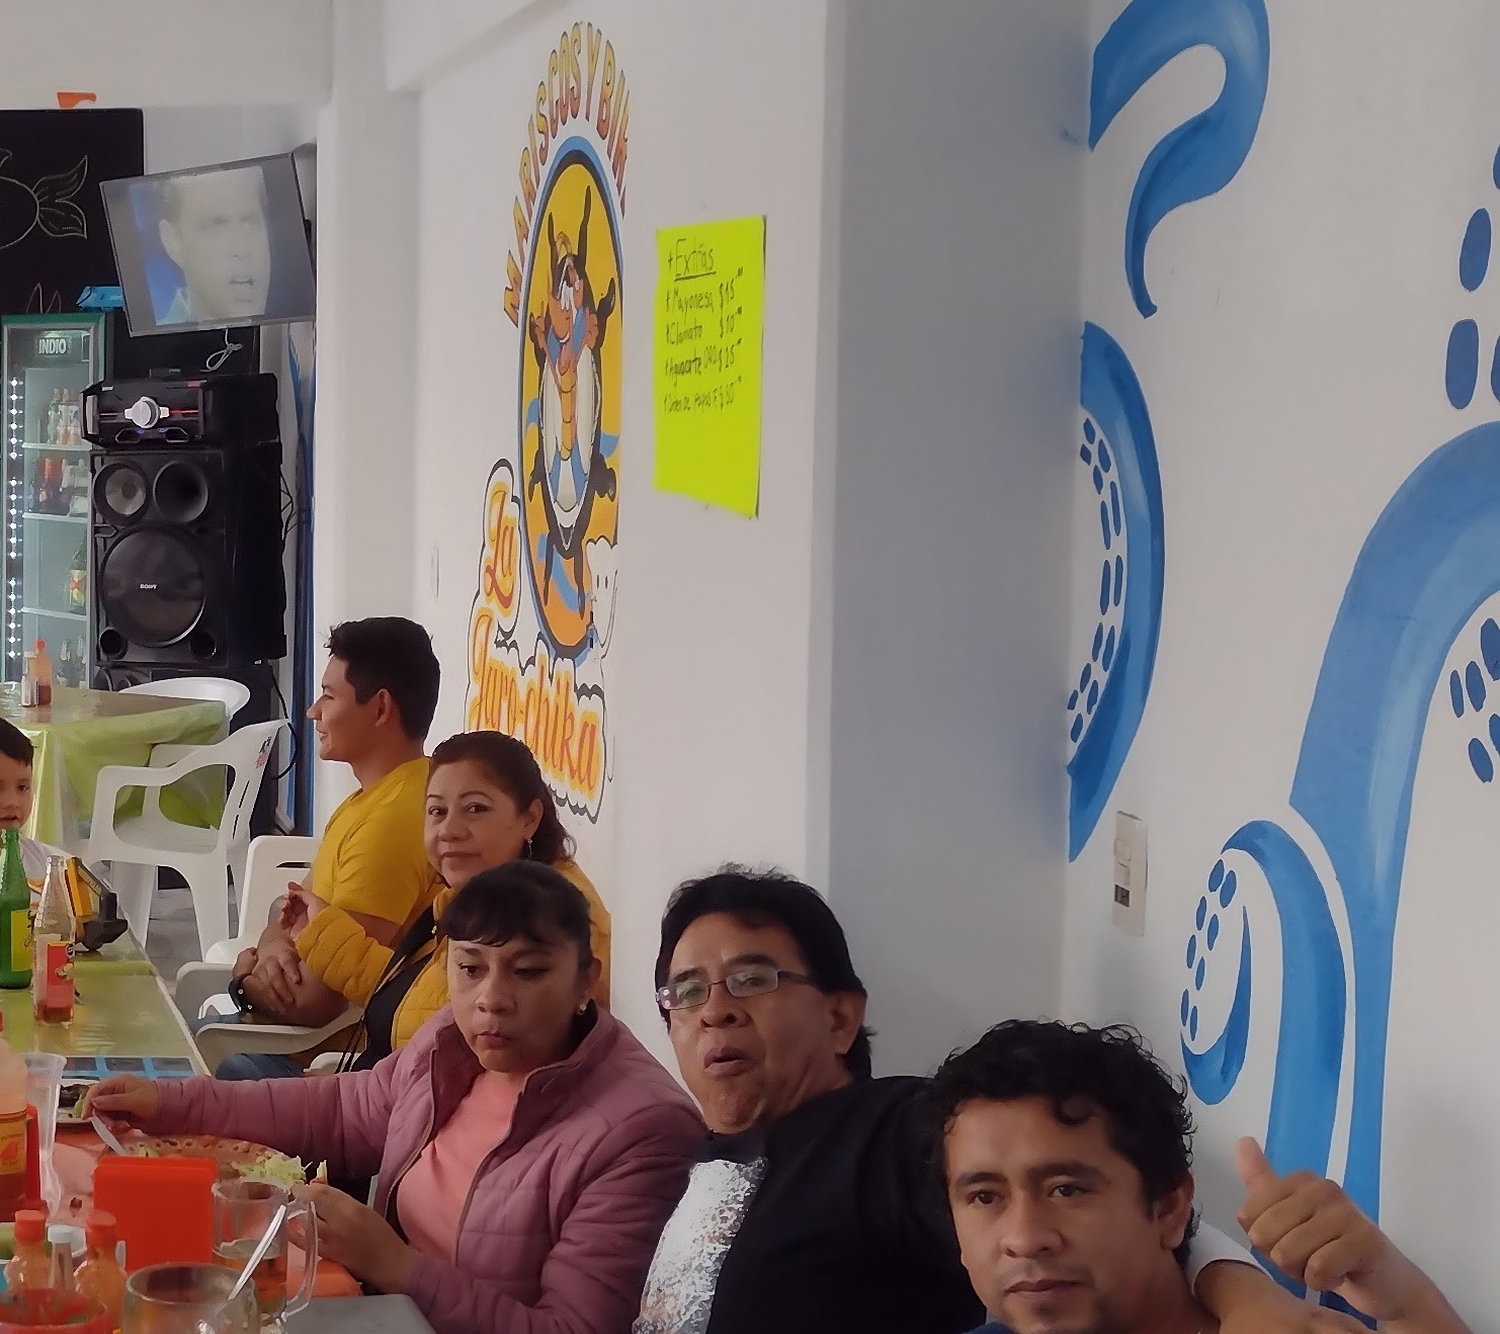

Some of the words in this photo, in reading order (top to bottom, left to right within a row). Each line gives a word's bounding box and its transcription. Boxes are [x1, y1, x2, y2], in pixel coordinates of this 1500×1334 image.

[503, 20, 583, 329] MARISCOS
[586, 20, 603, 123] Y
[38, 338, 67, 355] INDIO
[485, 482, 516, 610] La
